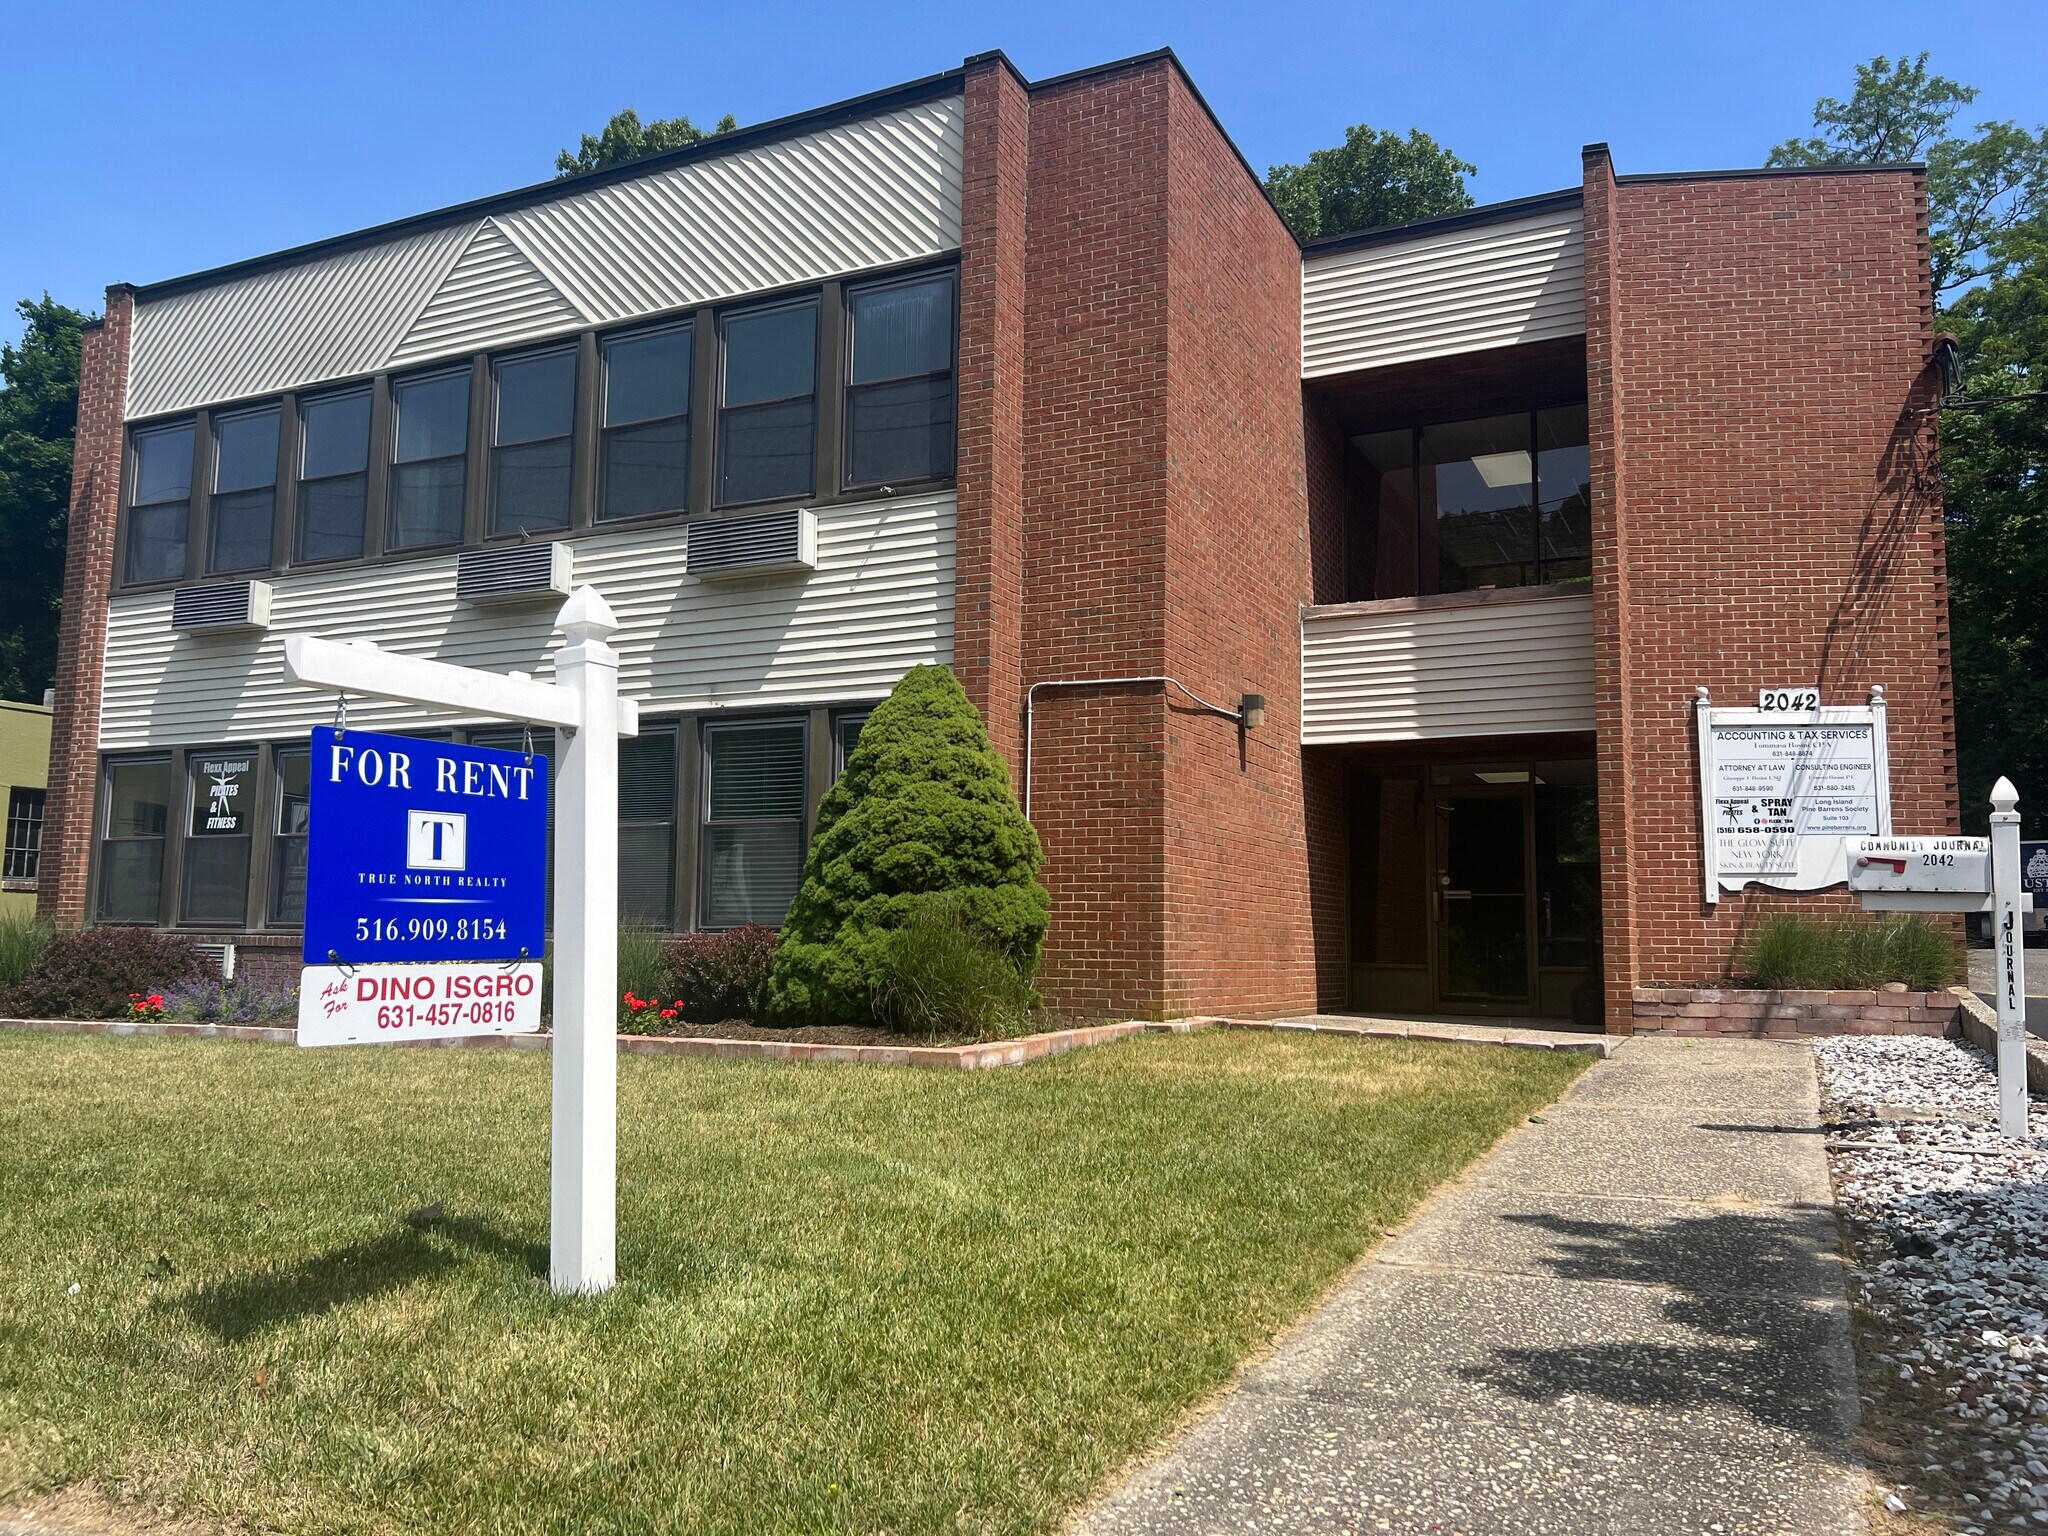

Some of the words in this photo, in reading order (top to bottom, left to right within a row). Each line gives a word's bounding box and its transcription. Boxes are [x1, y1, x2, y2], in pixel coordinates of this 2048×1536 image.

[1763, 693, 1816, 711] 2042
[1717, 731, 1786, 741] ACCOUNTING
[1788, 731, 1796, 740] &
[1799, 731, 1819, 740] TAX
[1821, 730, 1868, 739] SERVICES
[203, 762, 222, 774] Flexx
[223, 760, 249, 773] Appeal
[330, 745, 412, 790] FOR
[436, 757, 534, 801] RENT
[1840, 763, 1872, 771] ENGINEER
[210, 801, 217, 813] &
[1751, 805, 1759, 813] &
[1761, 799, 1793, 807] SPRAY
[1768, 808, 1787, 816] TAN
[206, 817, 237, 829] FITNESS
[421, 821, 454, 861] T
[1720, 839, 1733, 847] THE
[1738, 839, 1766, 847] GLOW
[1770, 839, 1794, 847] SUITE
[1923, 854, 1954, 866] 2042
[358, 873, 397, 885] TRUE
[404, 875, 450, 886] NORTH
[458, 876, 508, 888] REALTY
[355, 918, 507, 941] 516.909.8154
[2003, 911, 2015, 1009] JOURNAL
[320, 978, 349, 1001] Ask
[357, 976, 435, 1002] DINO
[445, 974, 534, 998] ISGRO
[323, 1000, 349, 1020] For
[377, 1000, 516, 1029] 631-457-0816
